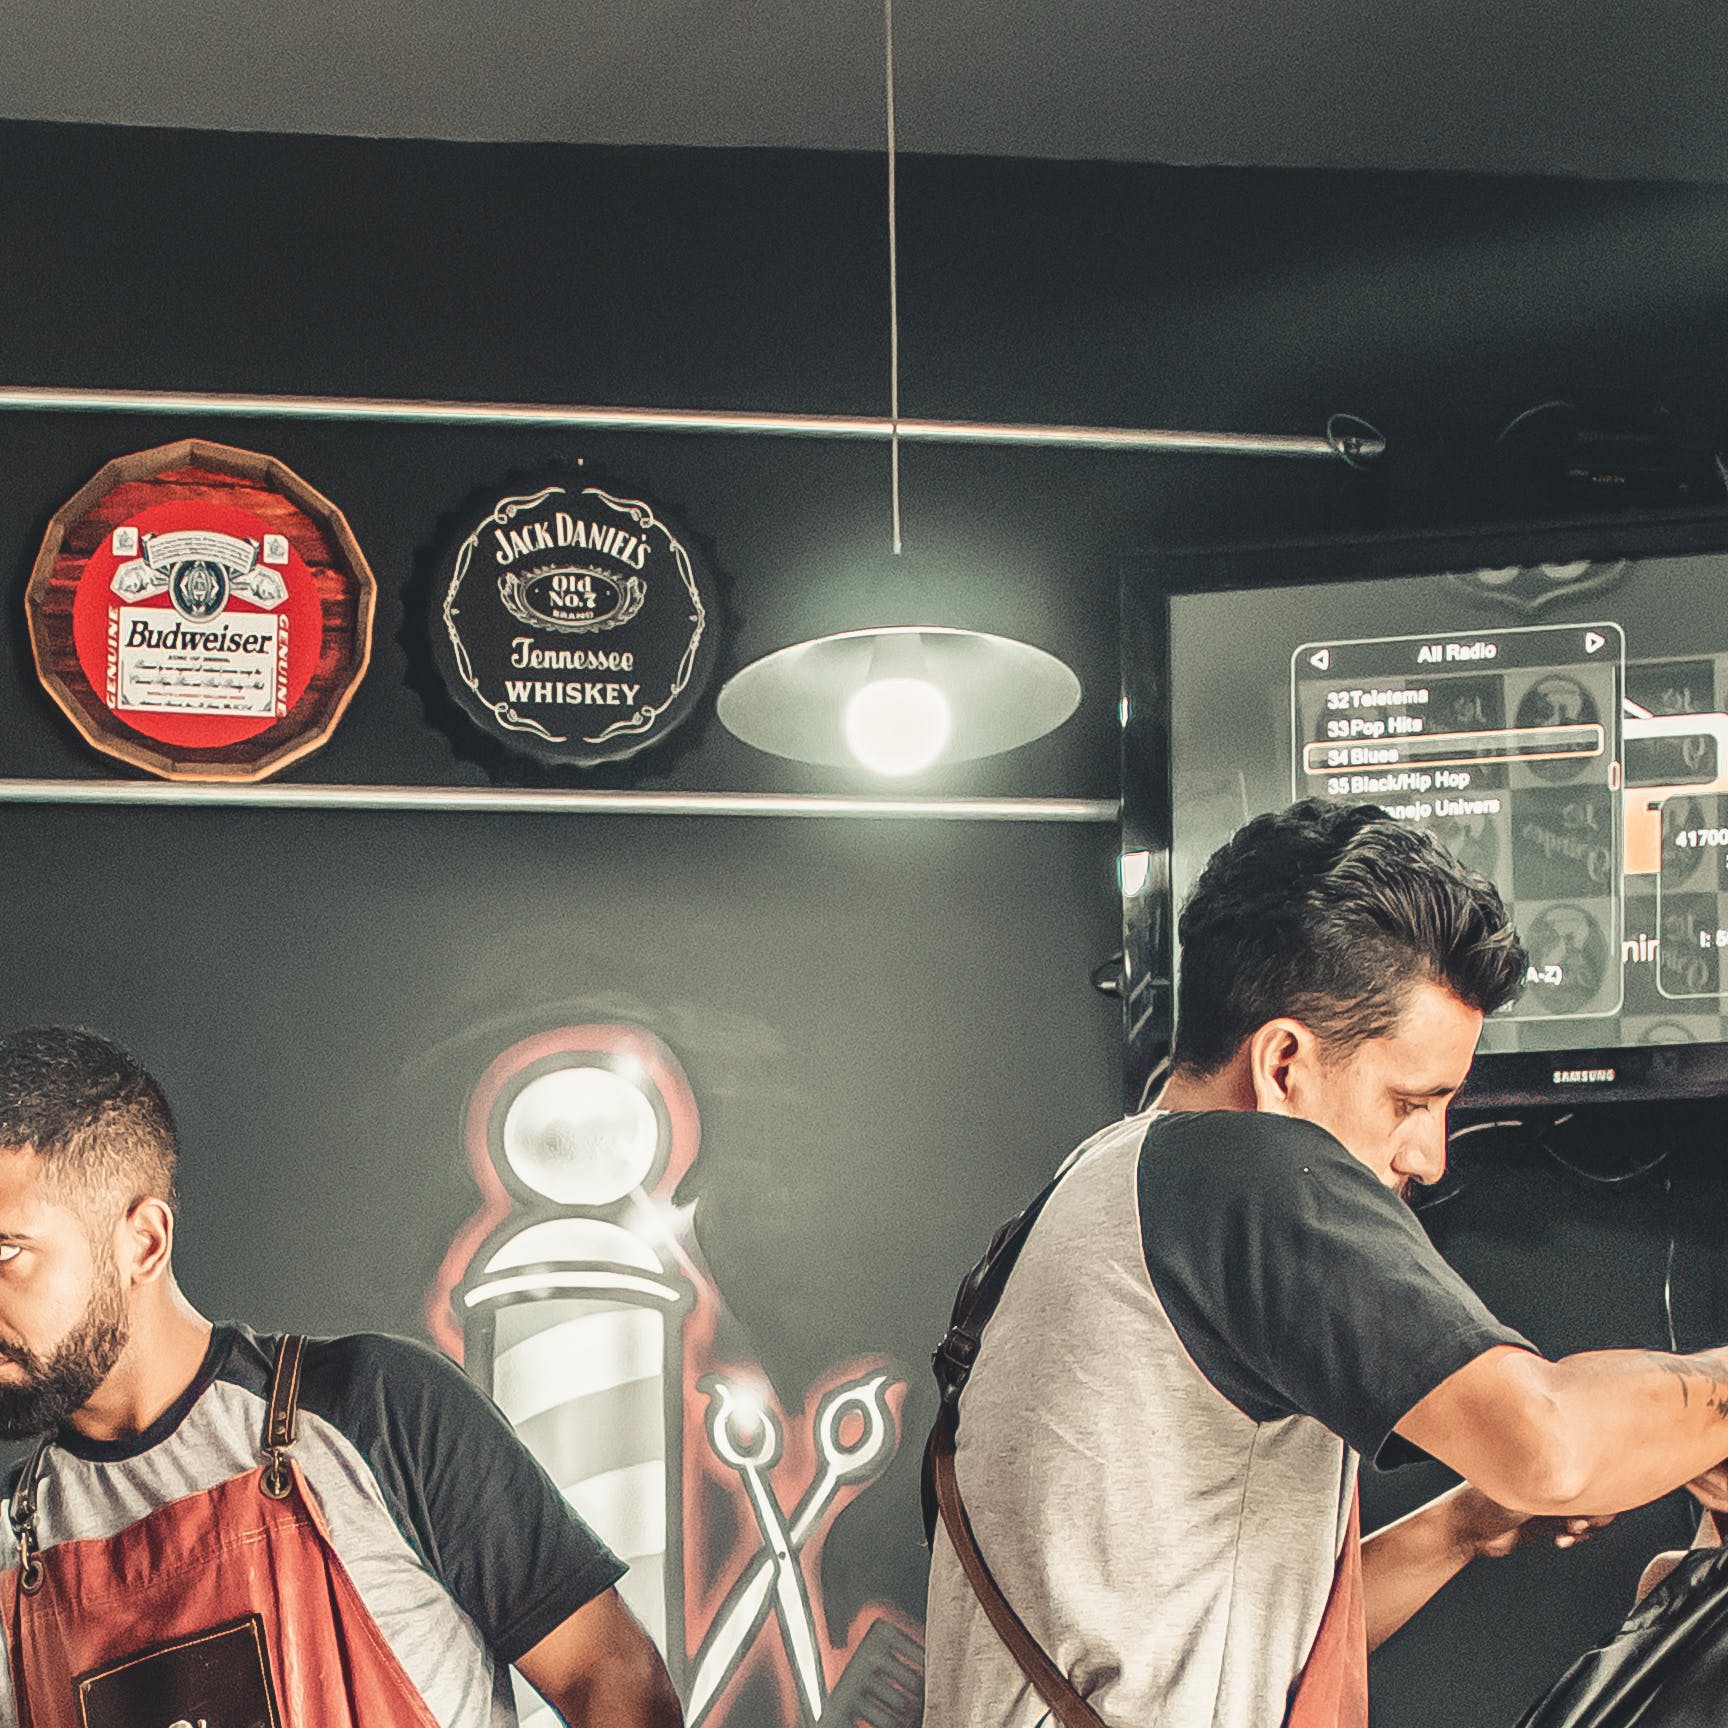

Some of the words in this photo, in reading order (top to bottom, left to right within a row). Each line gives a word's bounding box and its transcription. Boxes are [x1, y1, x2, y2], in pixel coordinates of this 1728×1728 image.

[494, 521, 554, 565] JACK
[552, 575, 592, 592] Old
[125, 620, 273, 655] Budweiser
[106, 605, 120, 709] GENUINE
[511, 636, 634, 672] Tennessee
[1417, 645, 1443, 663] All
[1445, 642, 1497, 662] Radio
[505, 680, 640, 706] WHISKEY
[1350, 718, 1384, 739] Pop
[1388, 716, 1424, 735] Hits
[1327, 777, 1349, 795] 35
[1350, 771, 1432, 794] Black/Hip
[1435, 770, 1471, 791] Hop
[1435, 799, 1501, 817] Univers
[1552, 1068, 1616, 1084] SAMSUNG
